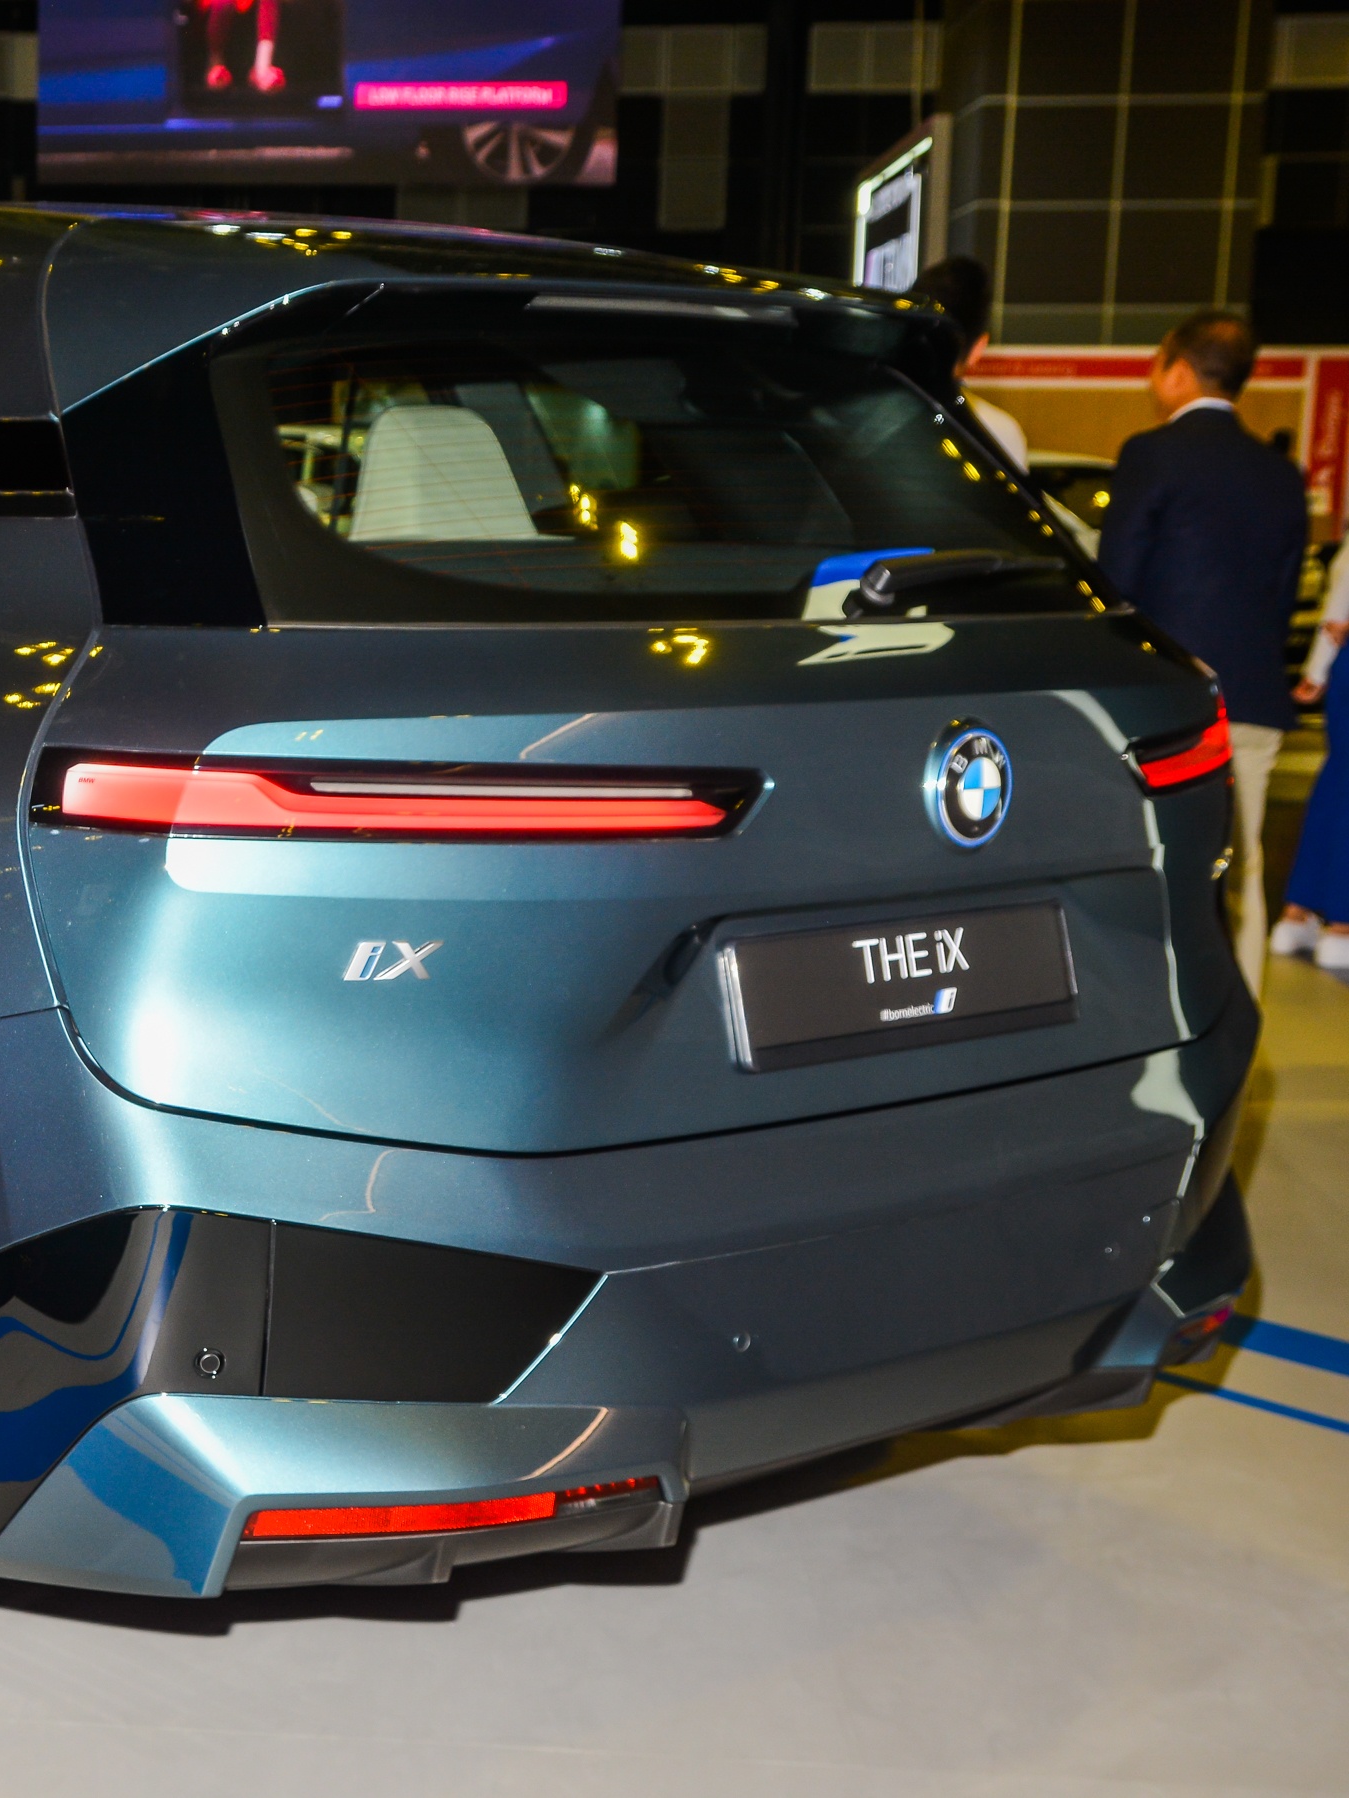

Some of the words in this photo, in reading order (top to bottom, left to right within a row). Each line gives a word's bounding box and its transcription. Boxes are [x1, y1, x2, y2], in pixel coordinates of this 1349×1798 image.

[481, 86, 552, 106] PLATFORM
[950, 737, 1006, 774] BMW
[852, 932, 933, 984] THE
[934, 926, 970, 975] iX
